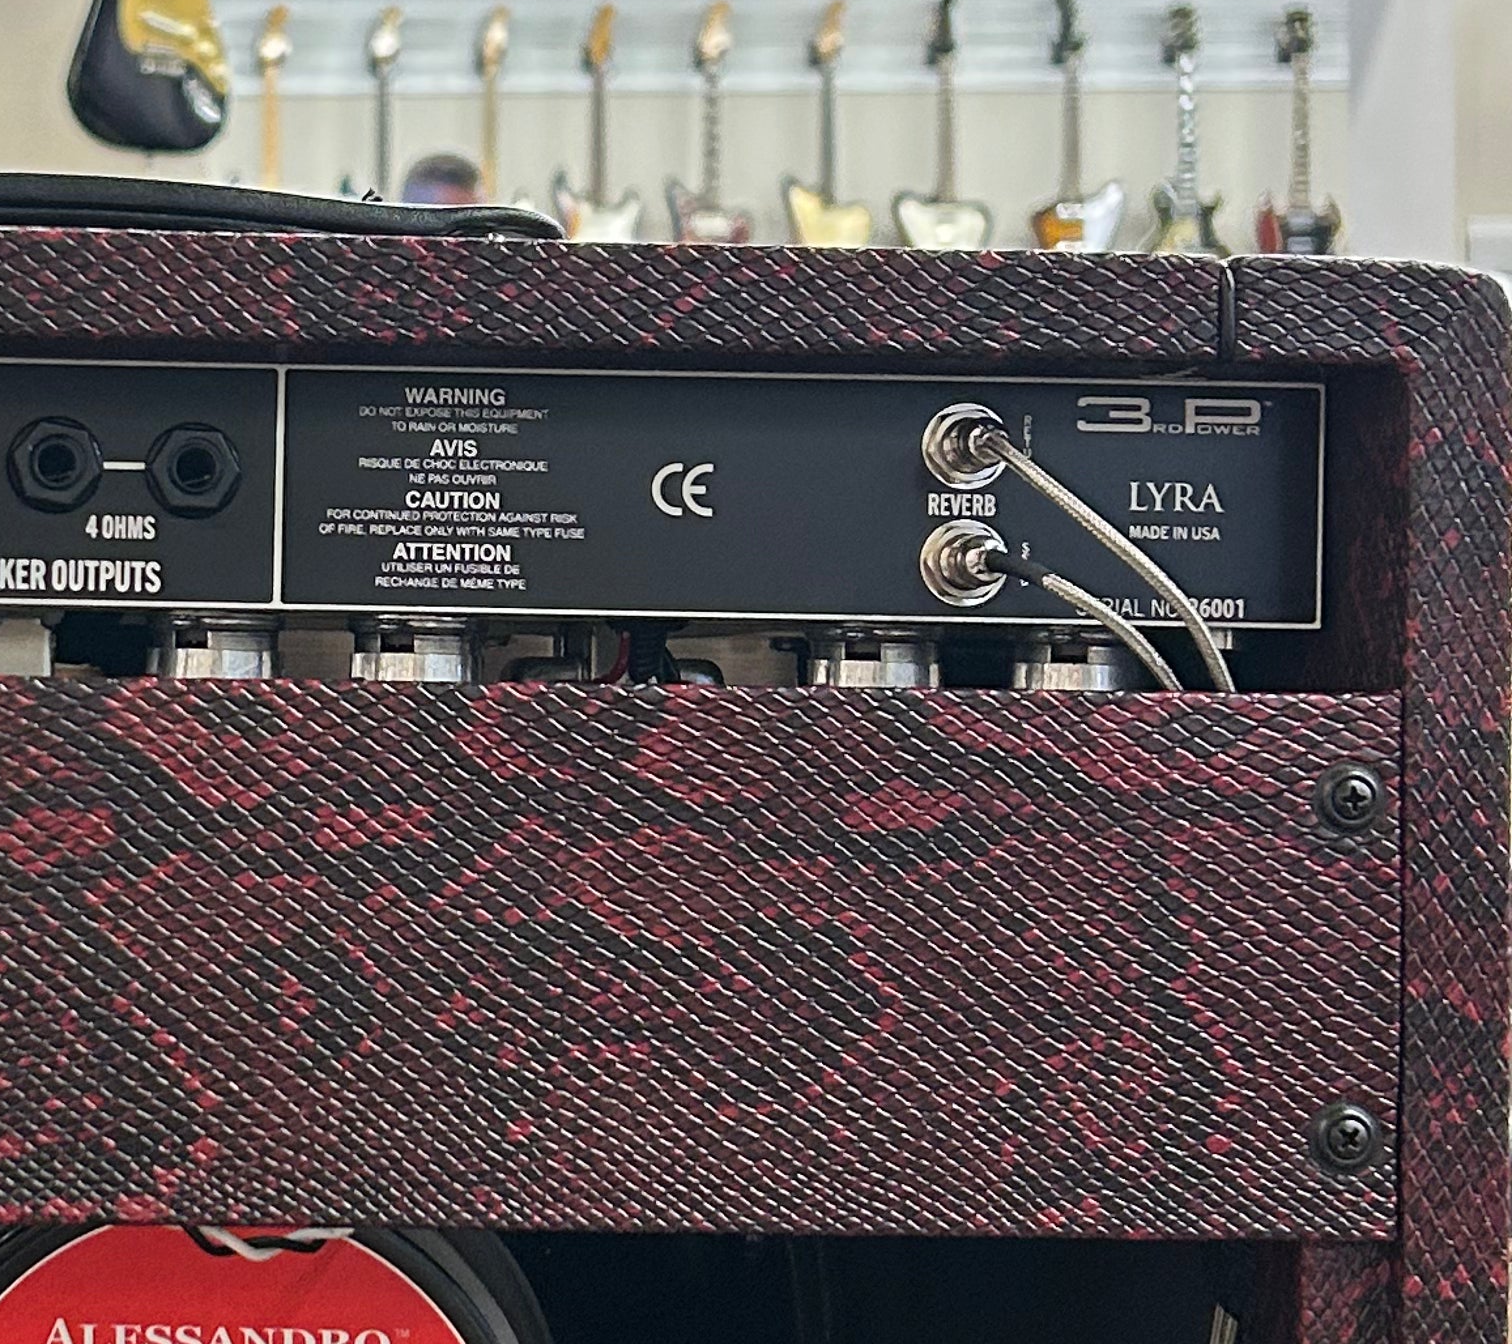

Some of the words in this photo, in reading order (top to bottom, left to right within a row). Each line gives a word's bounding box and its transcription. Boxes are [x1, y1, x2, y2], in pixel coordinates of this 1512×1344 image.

[405, 387, 506, 406] WARNING
[359, 406, 376, 417] DO
[379, 407, 402, 418] NOT
[405, 407, 451, 419] EXPOSE
[454, 408, 479, 419] THIS
[482, 408, 549, 420] EQUIPMENT
[392, 420, 405, 432] TO
[409, 421, 435, 433] RAIN
[438, 422, 456, 433] OR
[458, 422, 519, 434] MOISTURE
[430, 439, 478, 457] AVIS
[359, 457, 401, 469] RISQUE
[404, 459, 420, 470] DE
[423, 459, 457, 470] CHOC
[409, 474, 425, 484] NE
[428, 474, 450, 485] PAS
[452, 474, 497, 485] OUVRIR
[651, 462, 714, 517] CE
[1128, 481, 1225, 513] LYRA
[405, 490, 501, 510] CAUTION
[928, 493, 996, 516] REVERB
[326, 508, 351, 519] FOR
[352, 509, 420, 522] CONTINUED
[423, 510, 494, 523] PROTECTION
[498, 512, 547, 524] AGAINST
[550, 513, 577, 524] RISK
[85, 514, 98, 539] 4
[101, 515, 156, 540] OHMS
[319, 524, 335, 535] OF
[369, 525, 421, 537] REPLACE
[424, 526, 453, 537] ONLY
[455, 526, 485, 537] WITH
[488, 527, 520, 538] SAME
[523, 527, 552, 539] TYPE
[554, 528, 585, 539] FUSE
[1128, 525, 1170, 540] MADE
[1172, 526, 1188, 540] IN
[1191, 526, 1220, 541] USA
[393, 542, 511, 562] ATTENTION
[51, 560, 162, 593] OUTPUTS
[381, 562, 433, 574] UTILISER
[435, 563, 452, 574] UN
[455, 563, 501, 575] FUSIBLE
[504, 564, 520, 575] DE
[375, 577, 438, 588] RECHANGE
[441, 577, 458, 589] DE
[497, 578, 526, 591] TYPE
